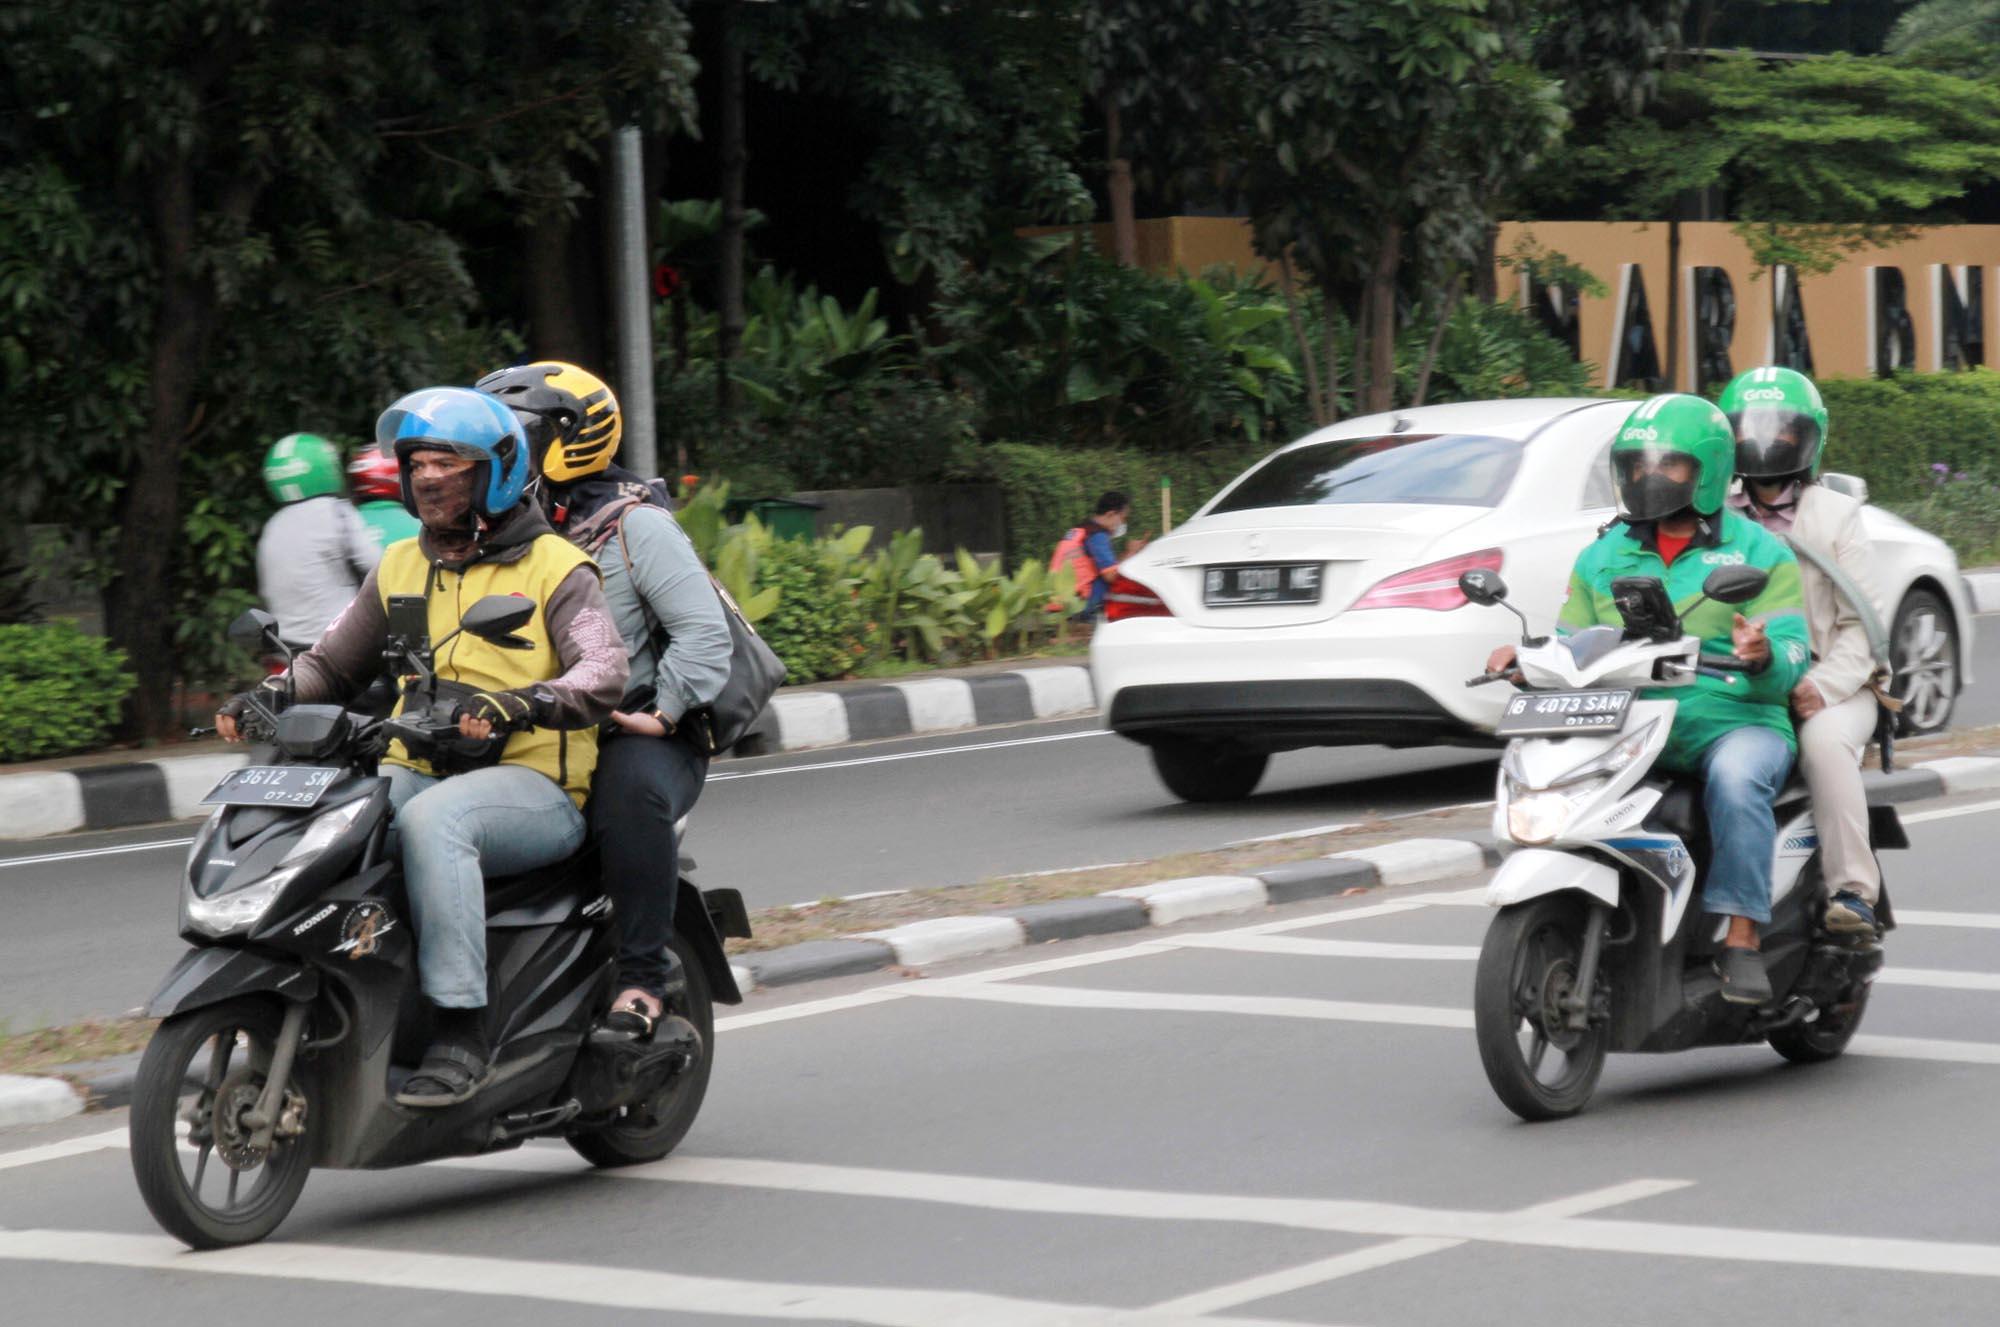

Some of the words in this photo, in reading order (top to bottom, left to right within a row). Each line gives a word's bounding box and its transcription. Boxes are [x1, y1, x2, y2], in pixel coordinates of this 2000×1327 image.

[1865, 264, 2000, 378] BN
[1743, 387, 1786, 401] Grab
[1623, 426, 1658, 441] Grab
[1702, 551, 1745, 565] Grab
[1512, 700, 1527, 715] B
[1534, 697, 1581, 714] 4073
[239, 770, 289, 785] 3612
[304, 771, 333, 786] SN
[292, 903, 339, 936] HONDA
